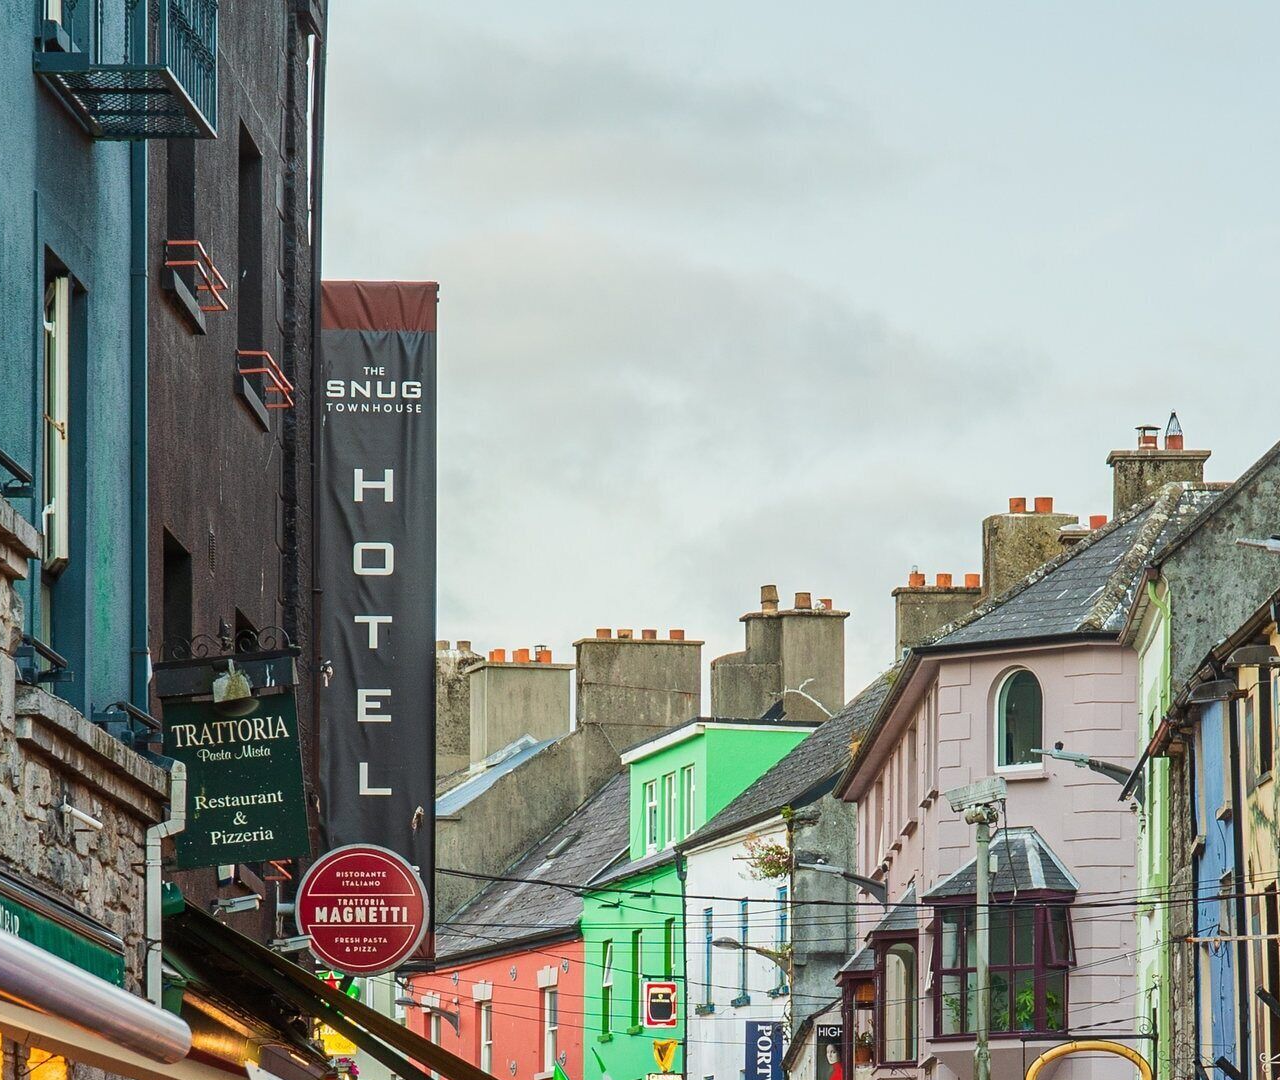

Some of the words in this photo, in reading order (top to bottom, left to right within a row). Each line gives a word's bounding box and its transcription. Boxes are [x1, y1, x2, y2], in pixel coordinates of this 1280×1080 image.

[363, 366, 385, 376] THE
[326, 380, 422, 398] SNUG
[326, 403, 422, 413] TOWNHOUSE
[353, 468, 394, 796] HOTEL
[171, 715, 290, 748] TRATTORIA
[197, 748, 232, 762] Pasta
[234, 744, 271, 760] Mista
[194, 790, 284, 810] Restaurant
[233, 811, 248, 826] &
[210, 826, 274, 846] Pizzeria
[337, 898, 385, 906] TRATTORIA
[315, 906, 408, 923] MAGNETTI
